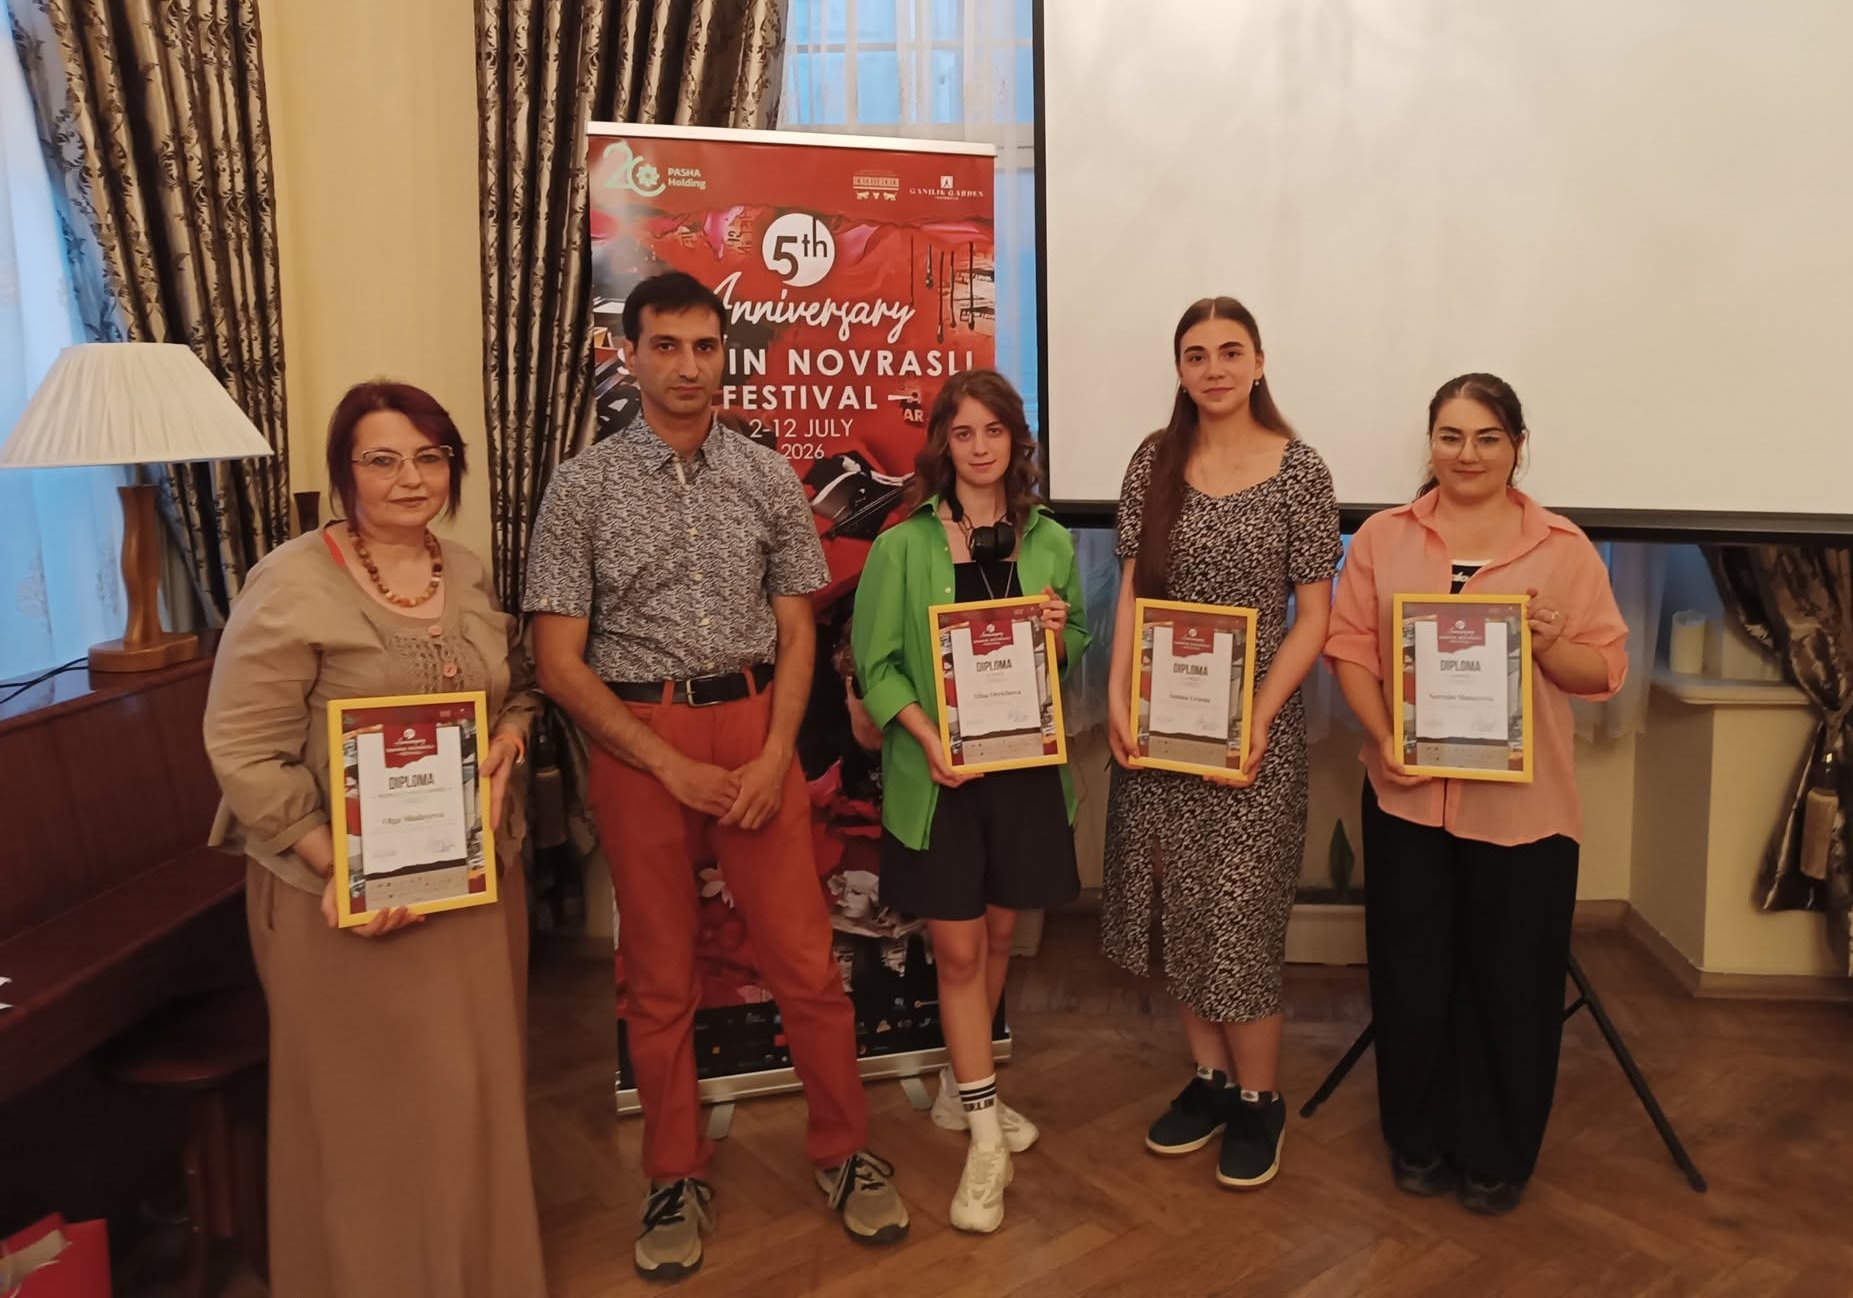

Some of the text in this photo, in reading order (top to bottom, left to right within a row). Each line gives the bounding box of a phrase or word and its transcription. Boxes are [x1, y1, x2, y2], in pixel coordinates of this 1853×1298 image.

[668, 168, 701, 177] PASHA
[668, 178, 706, 190] Holding
[773, 215, 828, 280] 5th
[713, 271, 916, 344] Anniversary
[788, 348, 973, 377] NOVRASLI
[722, 385, 878, 410] FESTIVAL
[749, 418, 853, 438] 2-12 JULY
[781, 443, 825, 460] 2026
[976, 659, 1013, 673] DIPLOMA
[1173, 662, 1208, 676] DIPLOMA
[1440, 660, 1481, 672] DIPLOMA
[388, 773, 435, 790] DIPLOMA
